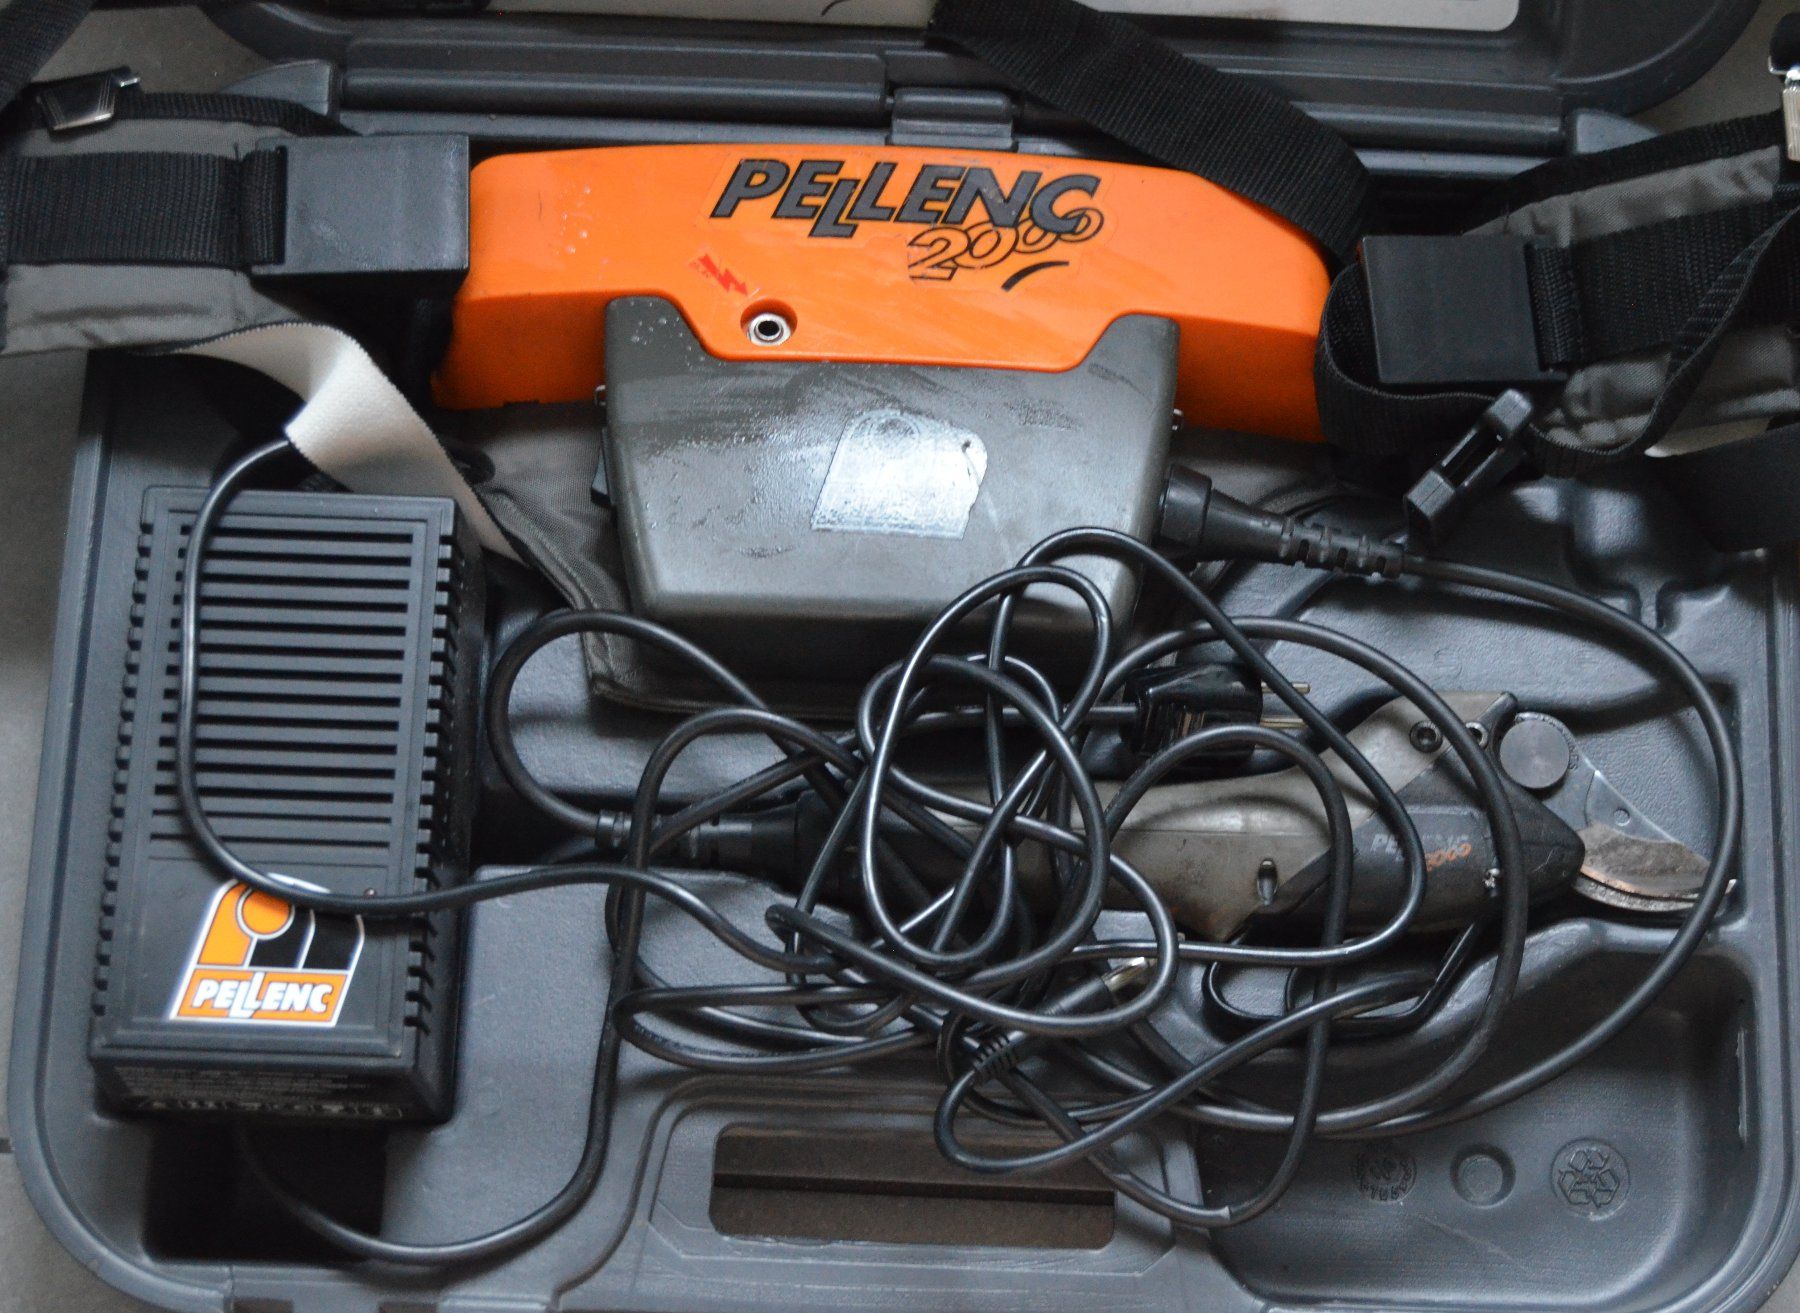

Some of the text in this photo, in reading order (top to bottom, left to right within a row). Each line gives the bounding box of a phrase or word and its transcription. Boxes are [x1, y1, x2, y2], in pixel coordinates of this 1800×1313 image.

[709, 157, 1102, 239] PELLENC
[907, 206, 1105, 282] 2000
[191, 970, 333, 1019] PELLENC
